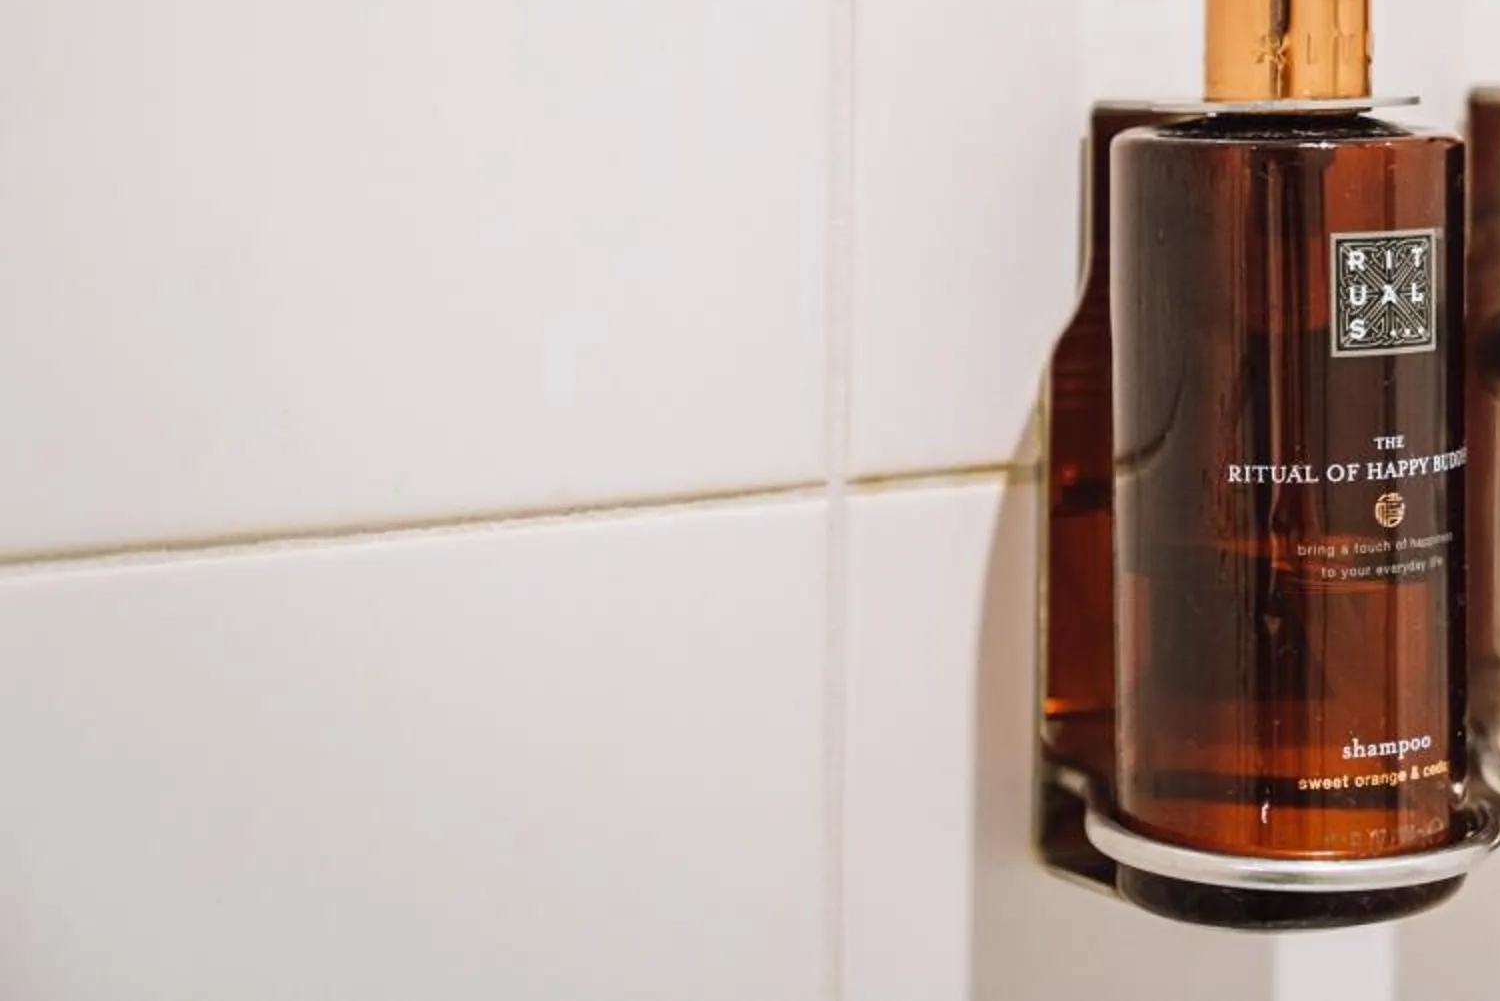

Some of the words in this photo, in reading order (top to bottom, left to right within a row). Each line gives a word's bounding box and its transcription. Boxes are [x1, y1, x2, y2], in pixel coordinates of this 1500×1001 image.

[1373, 435, 1405, 450] THE
[1227, 464, 1320, 484] RITUAL
[1325, 464, 1361, 482] OF
[1367, 456, 1430, 481] HAPPY
[1296, 543, 1335, 558] bring
[1340, 547, 1350, 557] a
[1355, 540, 1392, 555] touch
[1395, 538, 1408, 551] of
[1321, 565, 1338, 579] to
[1341, 565, 1373, 581] your
[1341, 735, 1432, 761] shampoo
[1298, 774, 1350, 791] sweet
[1354, 769, 1407, 788] orange
